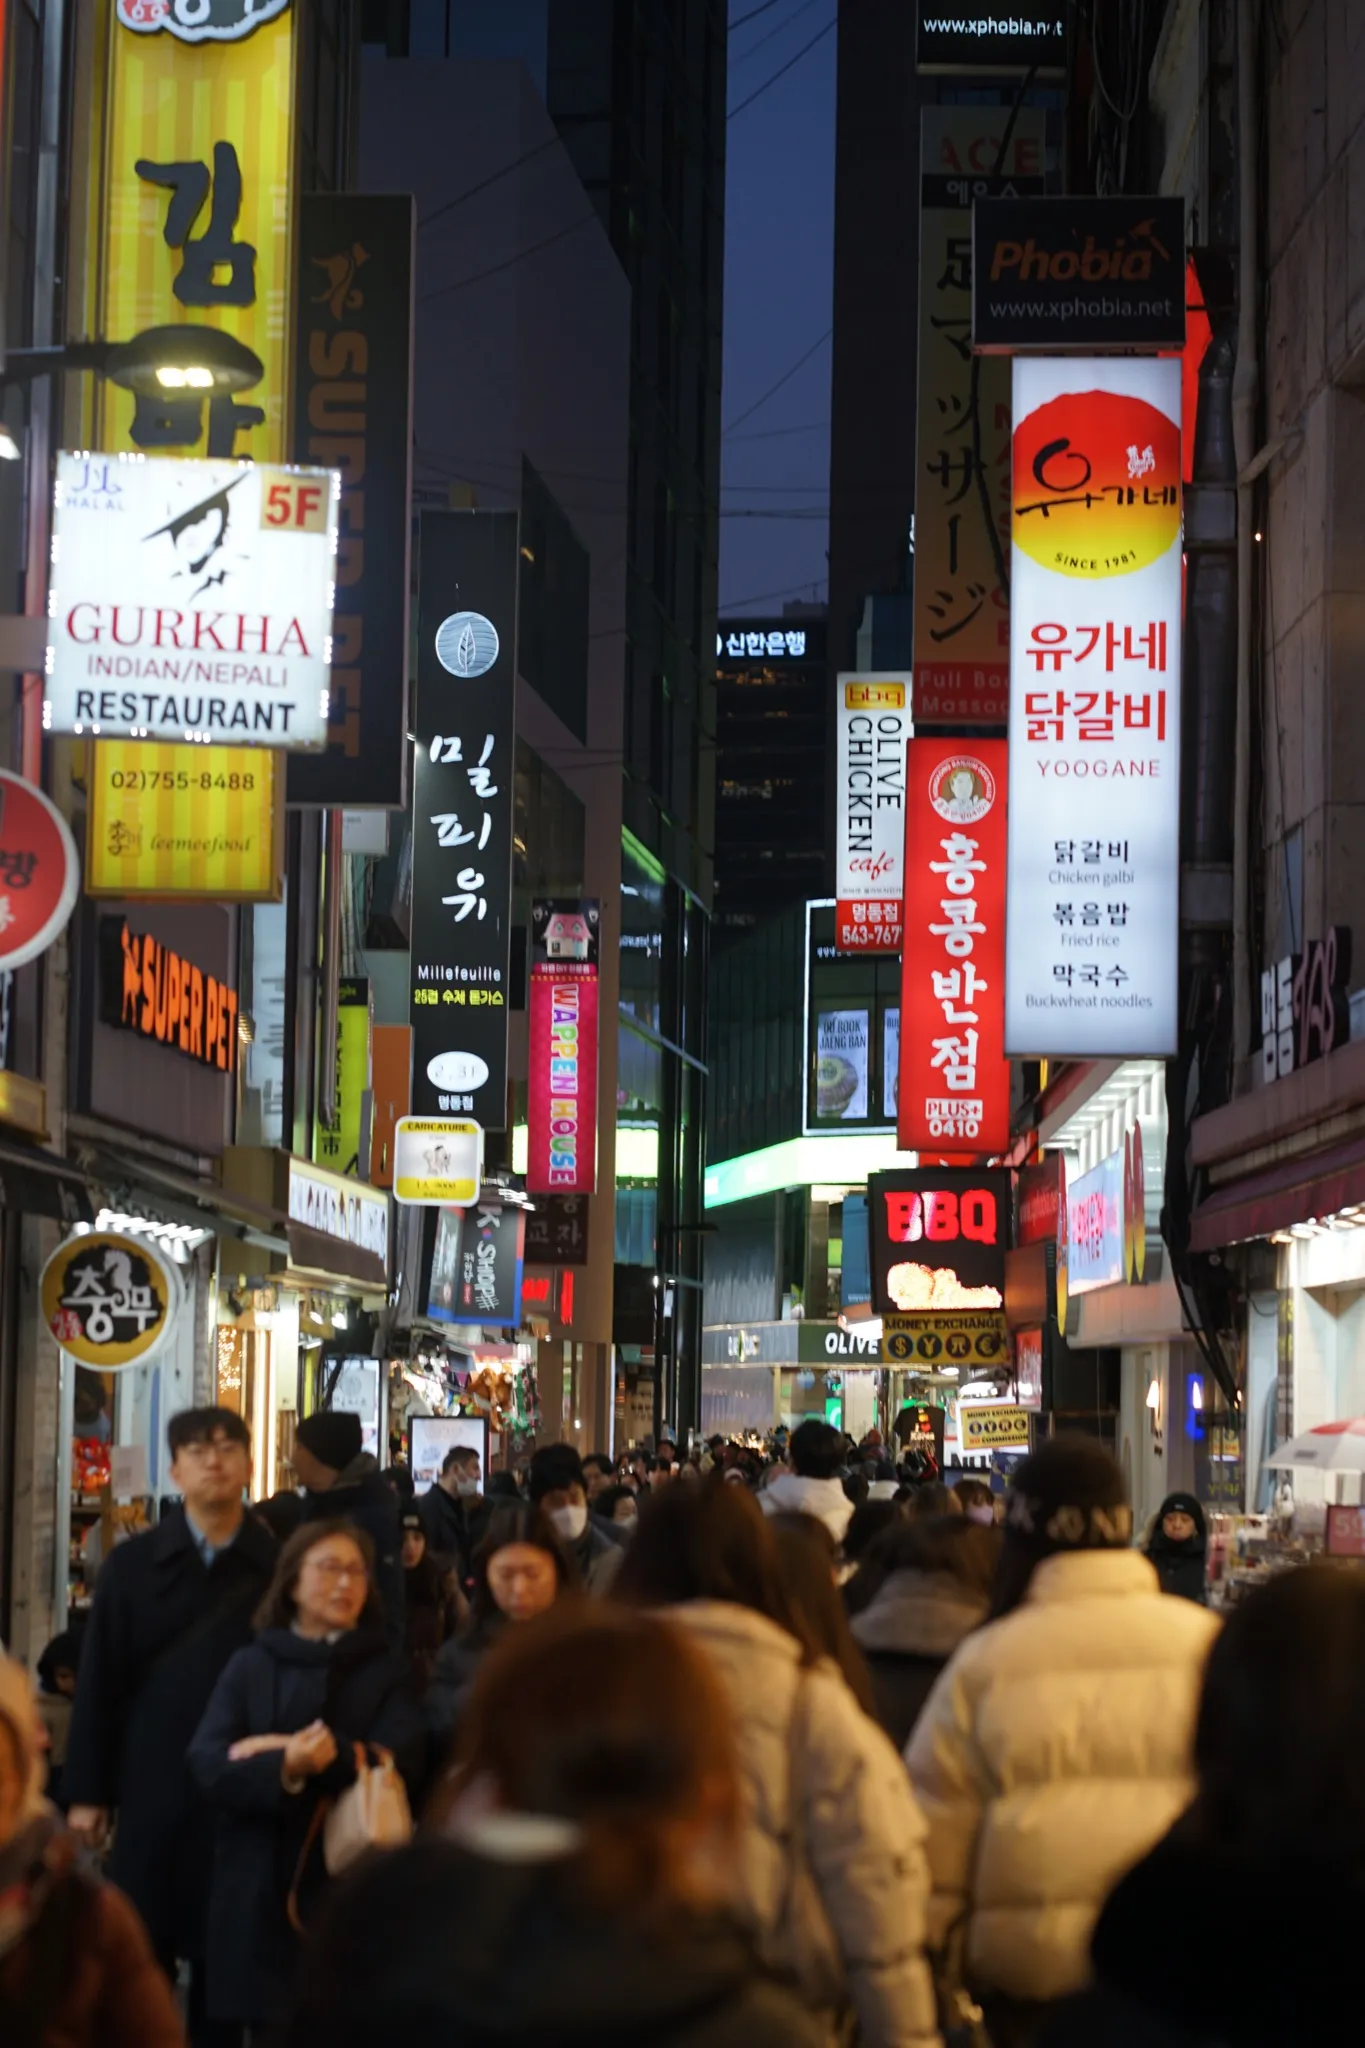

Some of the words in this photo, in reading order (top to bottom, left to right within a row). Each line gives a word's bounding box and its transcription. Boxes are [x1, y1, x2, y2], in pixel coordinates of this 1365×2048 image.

[923, 17, 1062, 37] www.xphobia.nt
[990, 236, 1153, 282] Phobia
[990, 299, 1171, 323] www.xphobia.net
[1015, 437, 1177, 518] 유가네
[265, 485, 321, 527] 5F
[1054, 551, 1098, 570] SINCE
[1104, 549, 1138, 569] 1981
[66, 601, 313, 658] GURKHA
[726, 631, 806, 656] 신한은행
[1026, 621, 1167, 673] 유가네
[88, 654, 288, 688] INDIAN/NEPALI
[919, 670, 961, 689] Full
[76, 690, 296, 732] RESTAURANT
[1025, 690, 1167, 741] 닭갈비
[877, 716, 904, 809] OLIVE
[1037, 760, 1161, 777] YOOGANE
[111, 771, 255, 792] 02)755-8488
[848, 716, 873, 852] CHICKEN
[1054, 840, 1129, 864] 닭갈비
[849, 851, 895, 880] cafe
[1048, 869, 1100, 885] Chicken
[1103, 869, 1135, 887] galbi
[1053, 902, 1130, 926] 볶음밥
[841, 924, 902, 945] 543-767
[1061, 932, 1094, 947] Fried
[1096, 933, 1120, 947] rice
[417, 964, 501, 982] Millefeuille
[928, 832, 988, 1090] 홍콩반점
[1053, 964, 1130, 988] 막국수
[141, 933, 202, 1056] SUPER
[205, 972, 238, 1073] PET
[1025, 993, 1098, 1008] Buckwheat
[1101, 993, 1153, 1009] noodles
[552, 983, 579, 1094] WAPPEN
[408, 1121, 468, 1132] CARICATURE
[929, 1119, 979, 1138] 0410
[549, 1098, 578, 1185] HOUSE
[884, 1189, 997, 1244] BBQ
[885, 1319, 931, 1330] MONEY
[934, 1318, 1002, 1330] EXCHANGE
[825, 1332, 878, 1355] OLIVE
